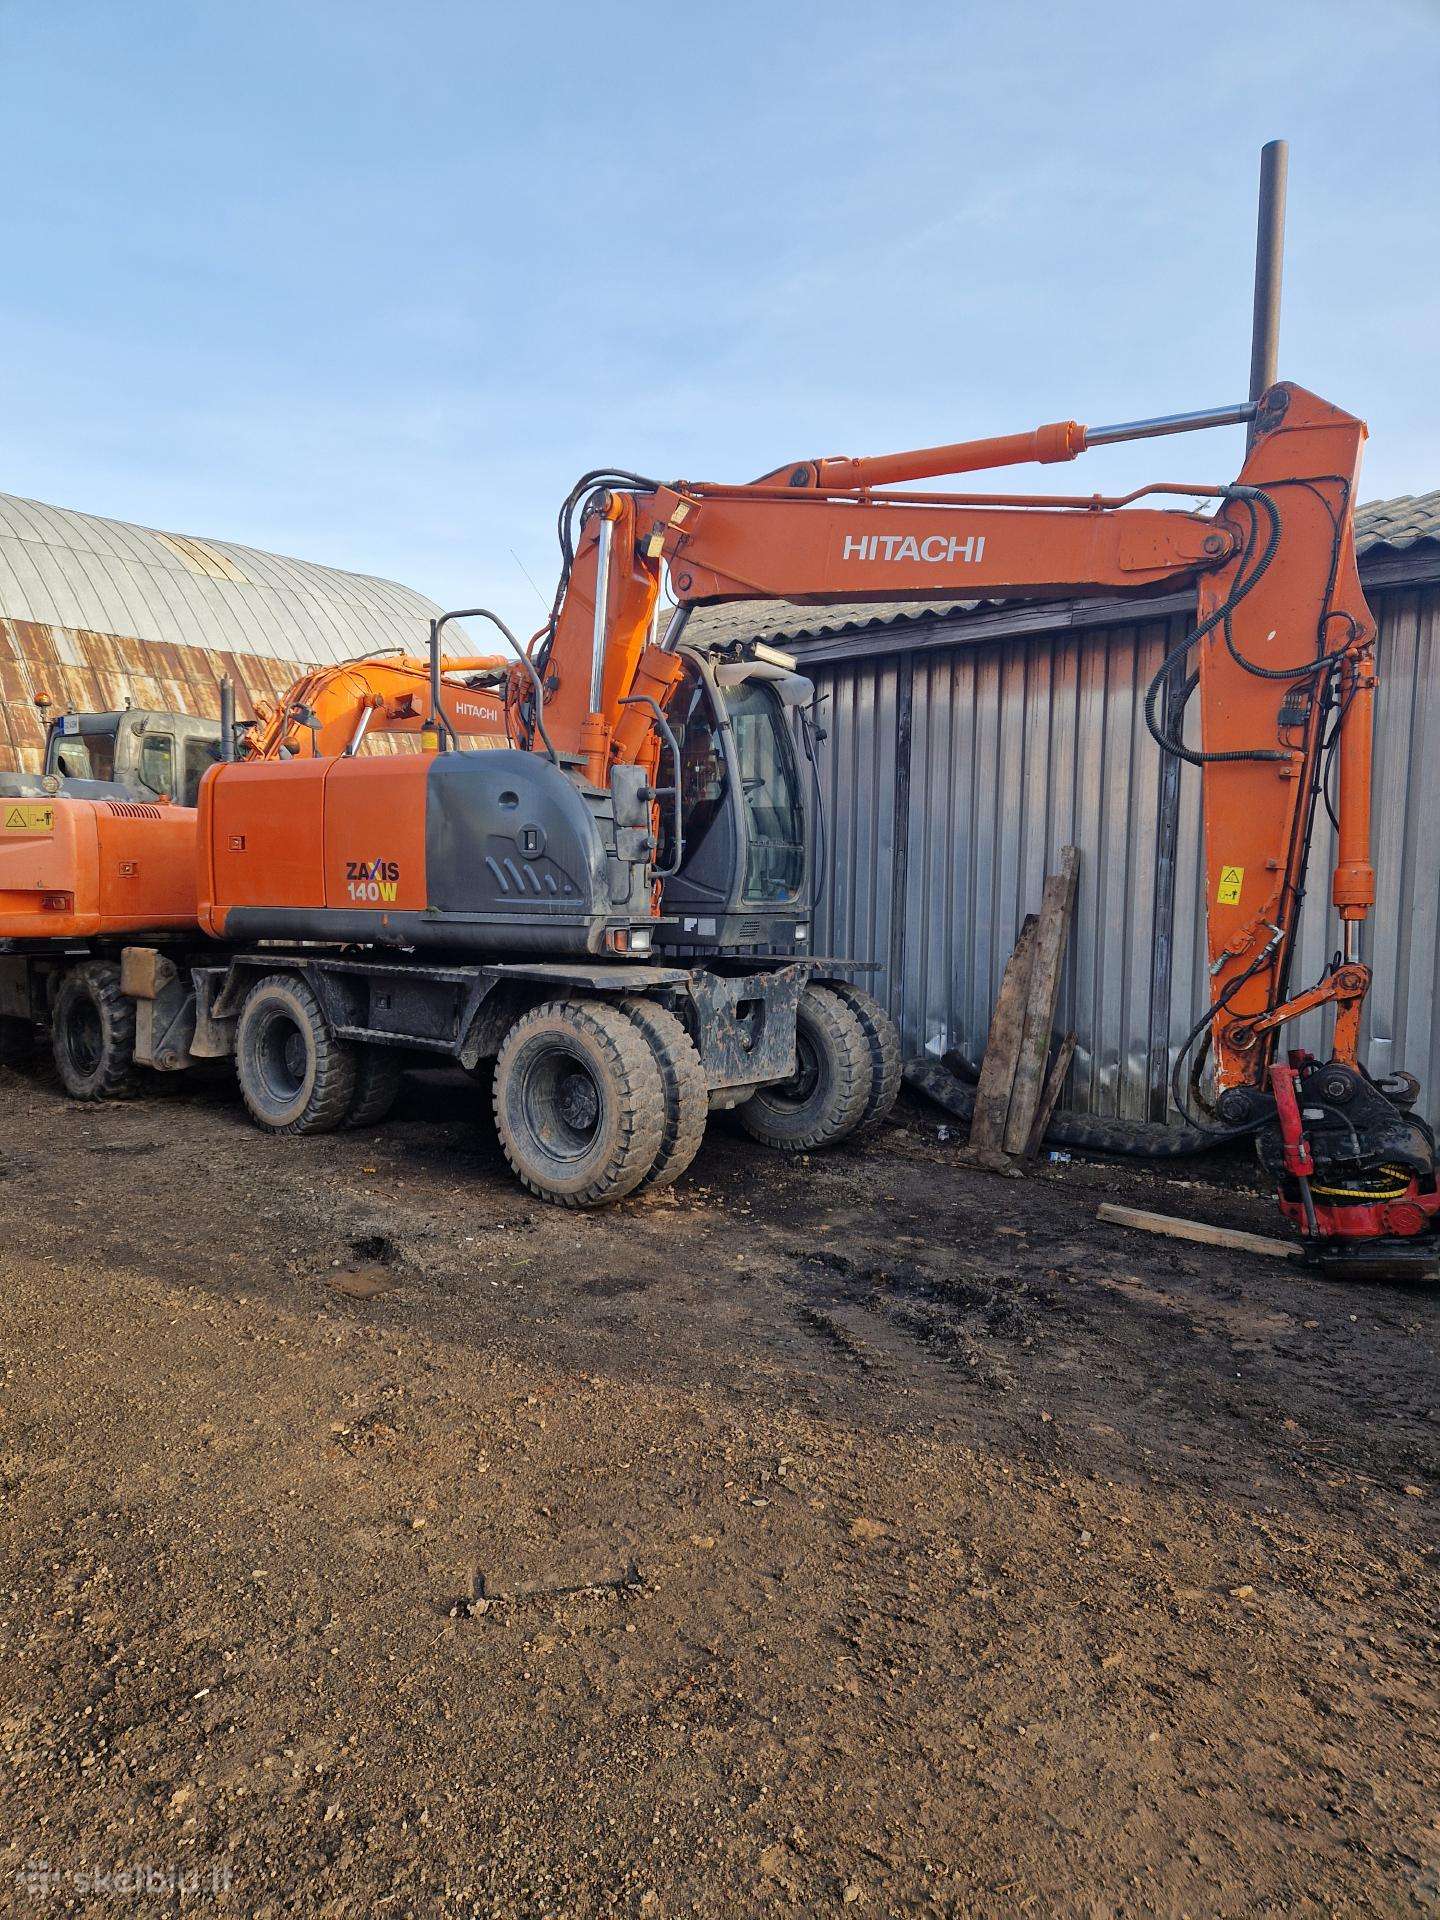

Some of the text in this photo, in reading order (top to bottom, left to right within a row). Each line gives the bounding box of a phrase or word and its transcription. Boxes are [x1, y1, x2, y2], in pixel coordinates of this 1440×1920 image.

[843, 535, 986, 562] HITACHI
[456, 701, 498, 721] HITACHI
[346, 858, 400, 881] ZAXIS
[347, 882, 398, 902] 140W
